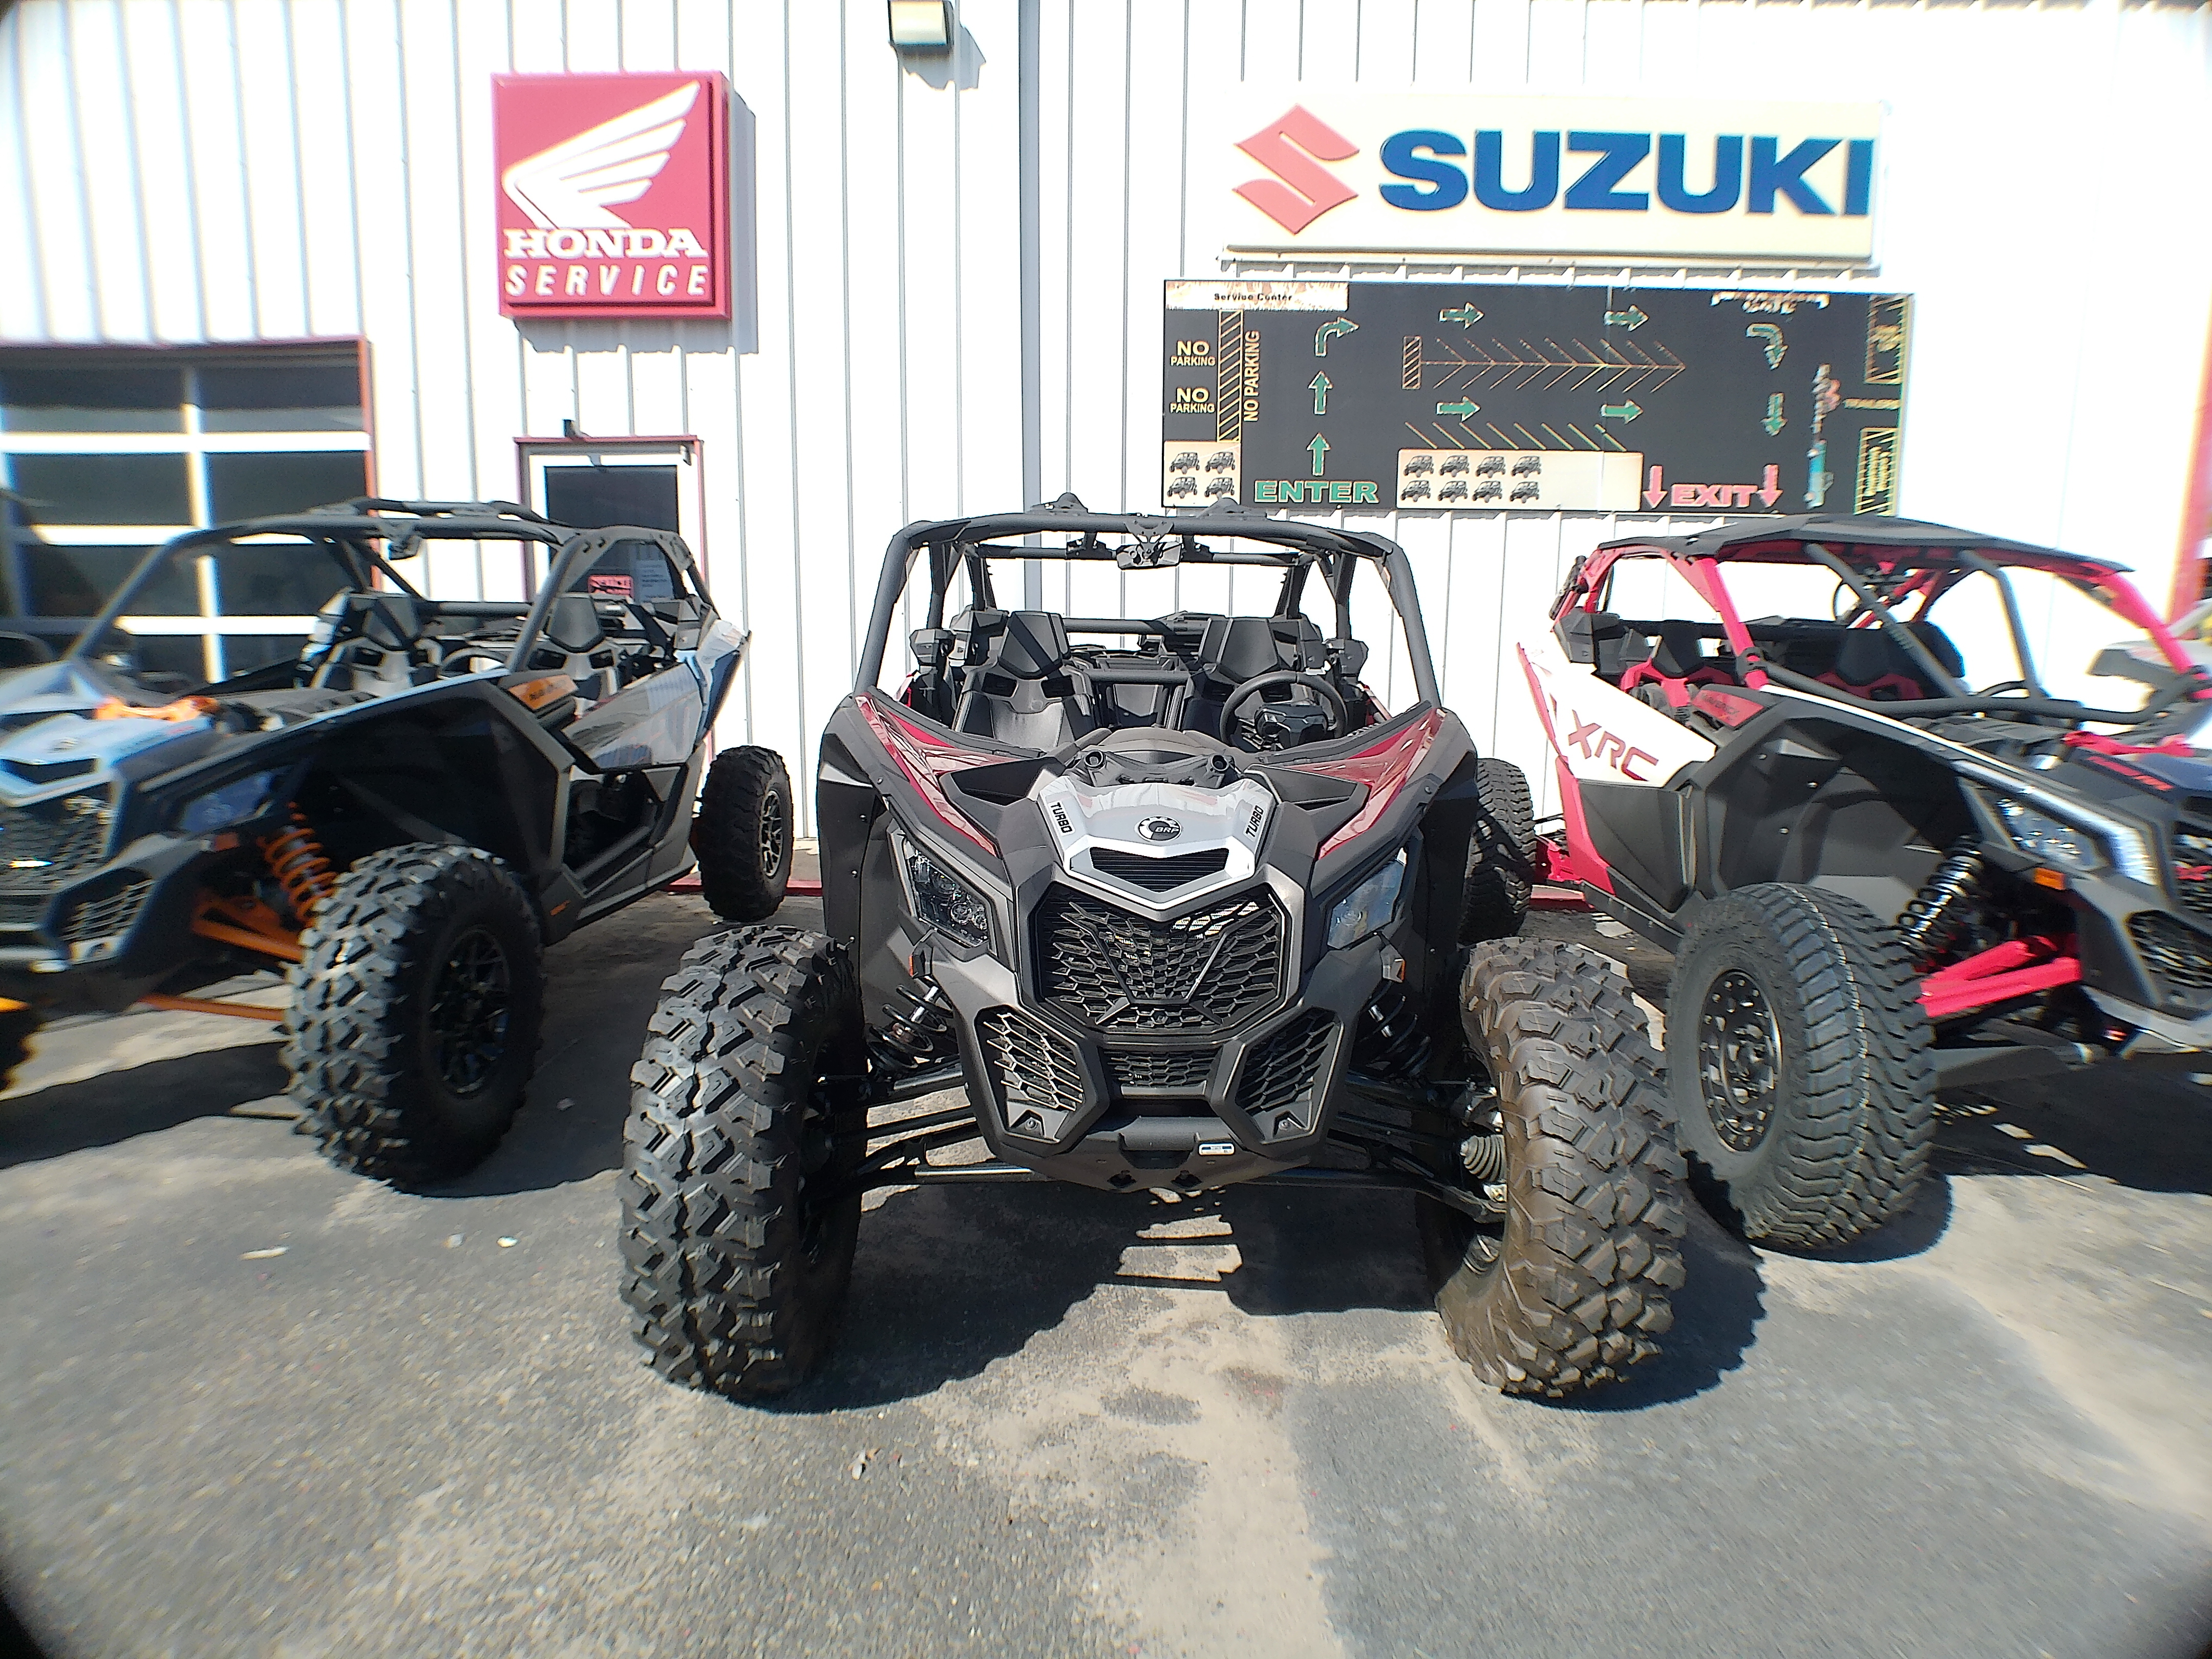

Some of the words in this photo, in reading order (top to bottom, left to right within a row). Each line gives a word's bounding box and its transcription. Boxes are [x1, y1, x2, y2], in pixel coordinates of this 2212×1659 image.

[1378, 129, 1875, 217] SUZUKI
[503, 228, 709, 259] HONDA
[505, 264, 708, 296] SERVICE
[1214, 292, 1253, 301] Service
[1257, 292, 1293, 301] Center
[1177, 340, 1210, 356] NO
[1170, 356, 1216, 367] PARKING
[1244, 330, 1261, 397] PARKING
[1176, 387, 1209, 403] NO
[1170, 403, 1216, 414] PARKING
[1244, 399, 1259, 422] NO
[1254, 480, 1379, 504] ENTER
[1671, 484, 1758, 507] EXIT
[1568, 709, 1659, 782] XRC
[1050, 802, 1072, 834] TURBO
[1245, 804, 1264, 838] TURBO
